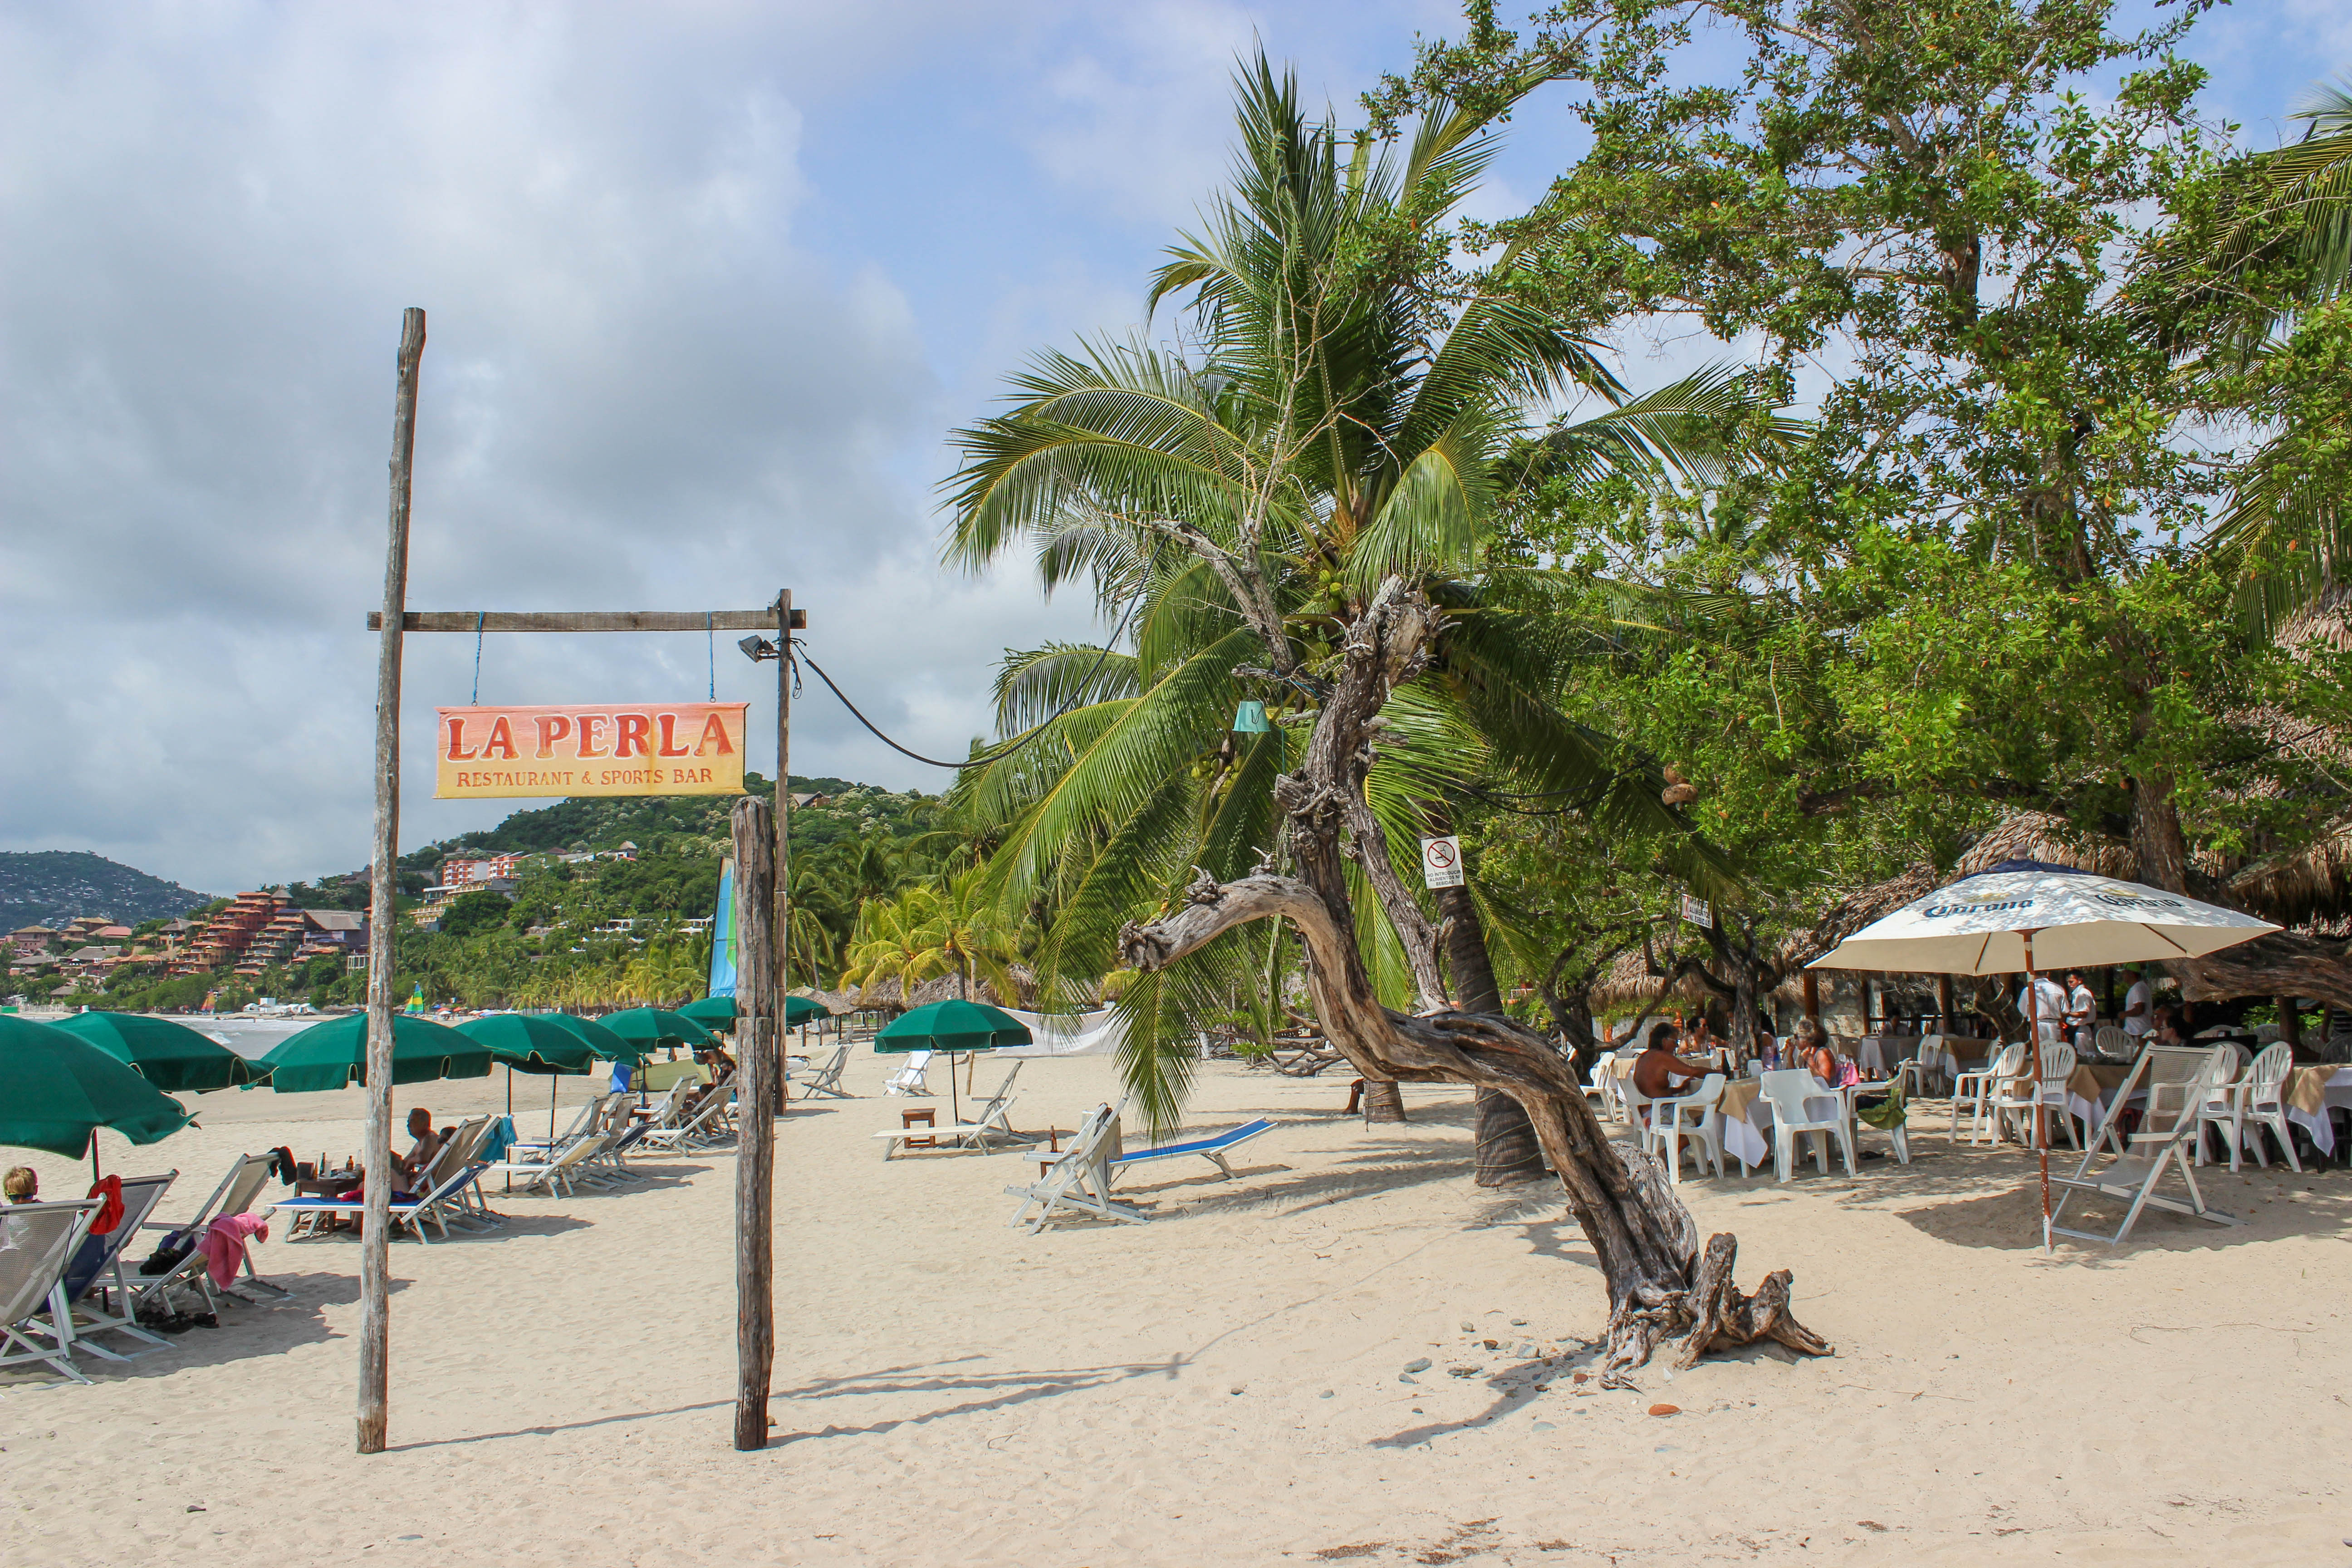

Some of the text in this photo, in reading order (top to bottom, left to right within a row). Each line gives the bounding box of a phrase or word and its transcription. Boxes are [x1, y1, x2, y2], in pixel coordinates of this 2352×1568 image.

[447, 713, 735, 761] LA PERLA
[457, 768, 713, 787] RESTAURANT & SPORTS BAR
[1923, 900, 2034, 918] Corona
[2094, 895, 2185, 908] Corona
